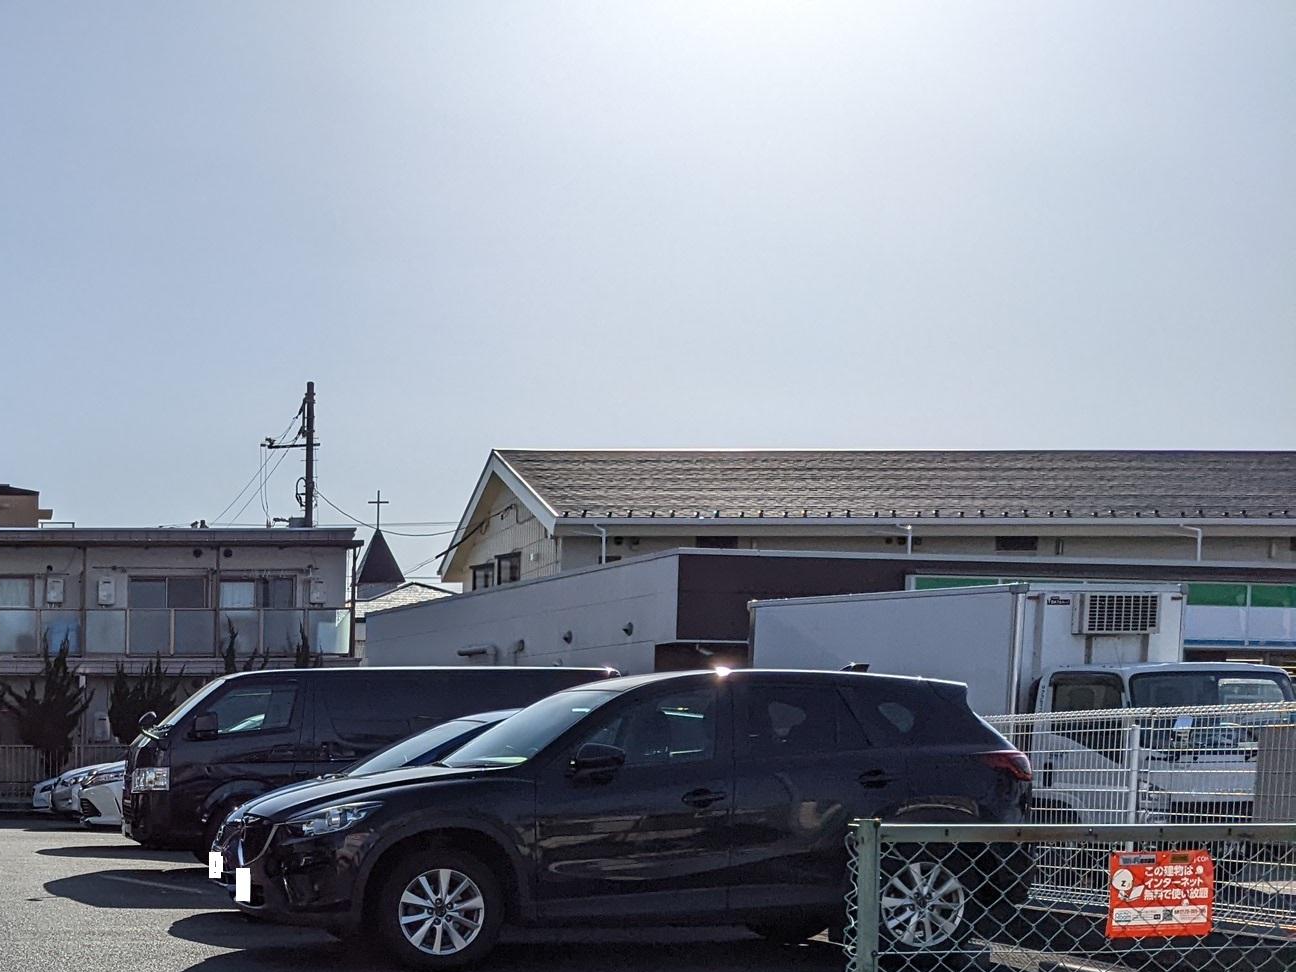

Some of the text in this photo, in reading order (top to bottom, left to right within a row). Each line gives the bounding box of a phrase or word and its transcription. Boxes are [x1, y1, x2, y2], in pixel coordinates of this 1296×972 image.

[1145, 865, 1193, 876] この建物は
[1145, 877, 1203, 888] インターネット
[1144, 888, 1208, 900] 無料で使い放題
